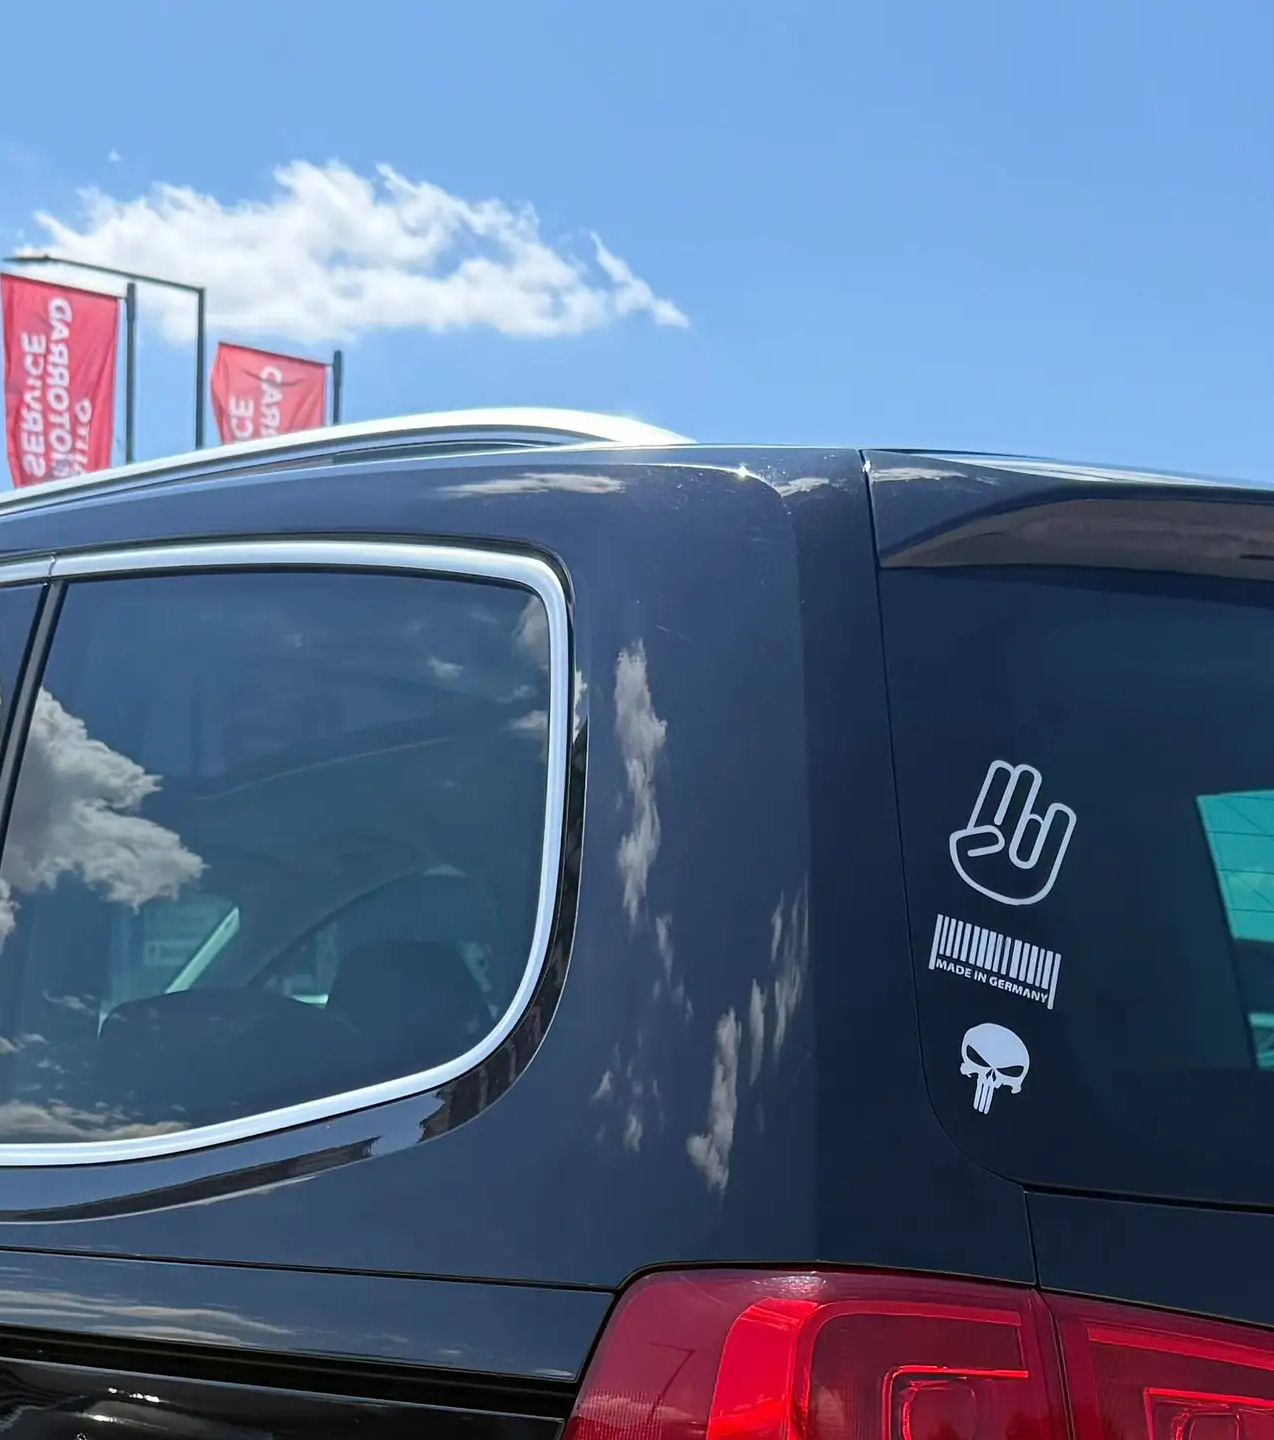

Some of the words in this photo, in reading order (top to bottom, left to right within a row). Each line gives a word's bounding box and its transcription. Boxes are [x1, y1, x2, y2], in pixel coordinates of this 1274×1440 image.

[936, 959, 971, 978] MADE
[974, 971, 987, 984] IN
[989, 977, 1048, 1003] GERMANY
